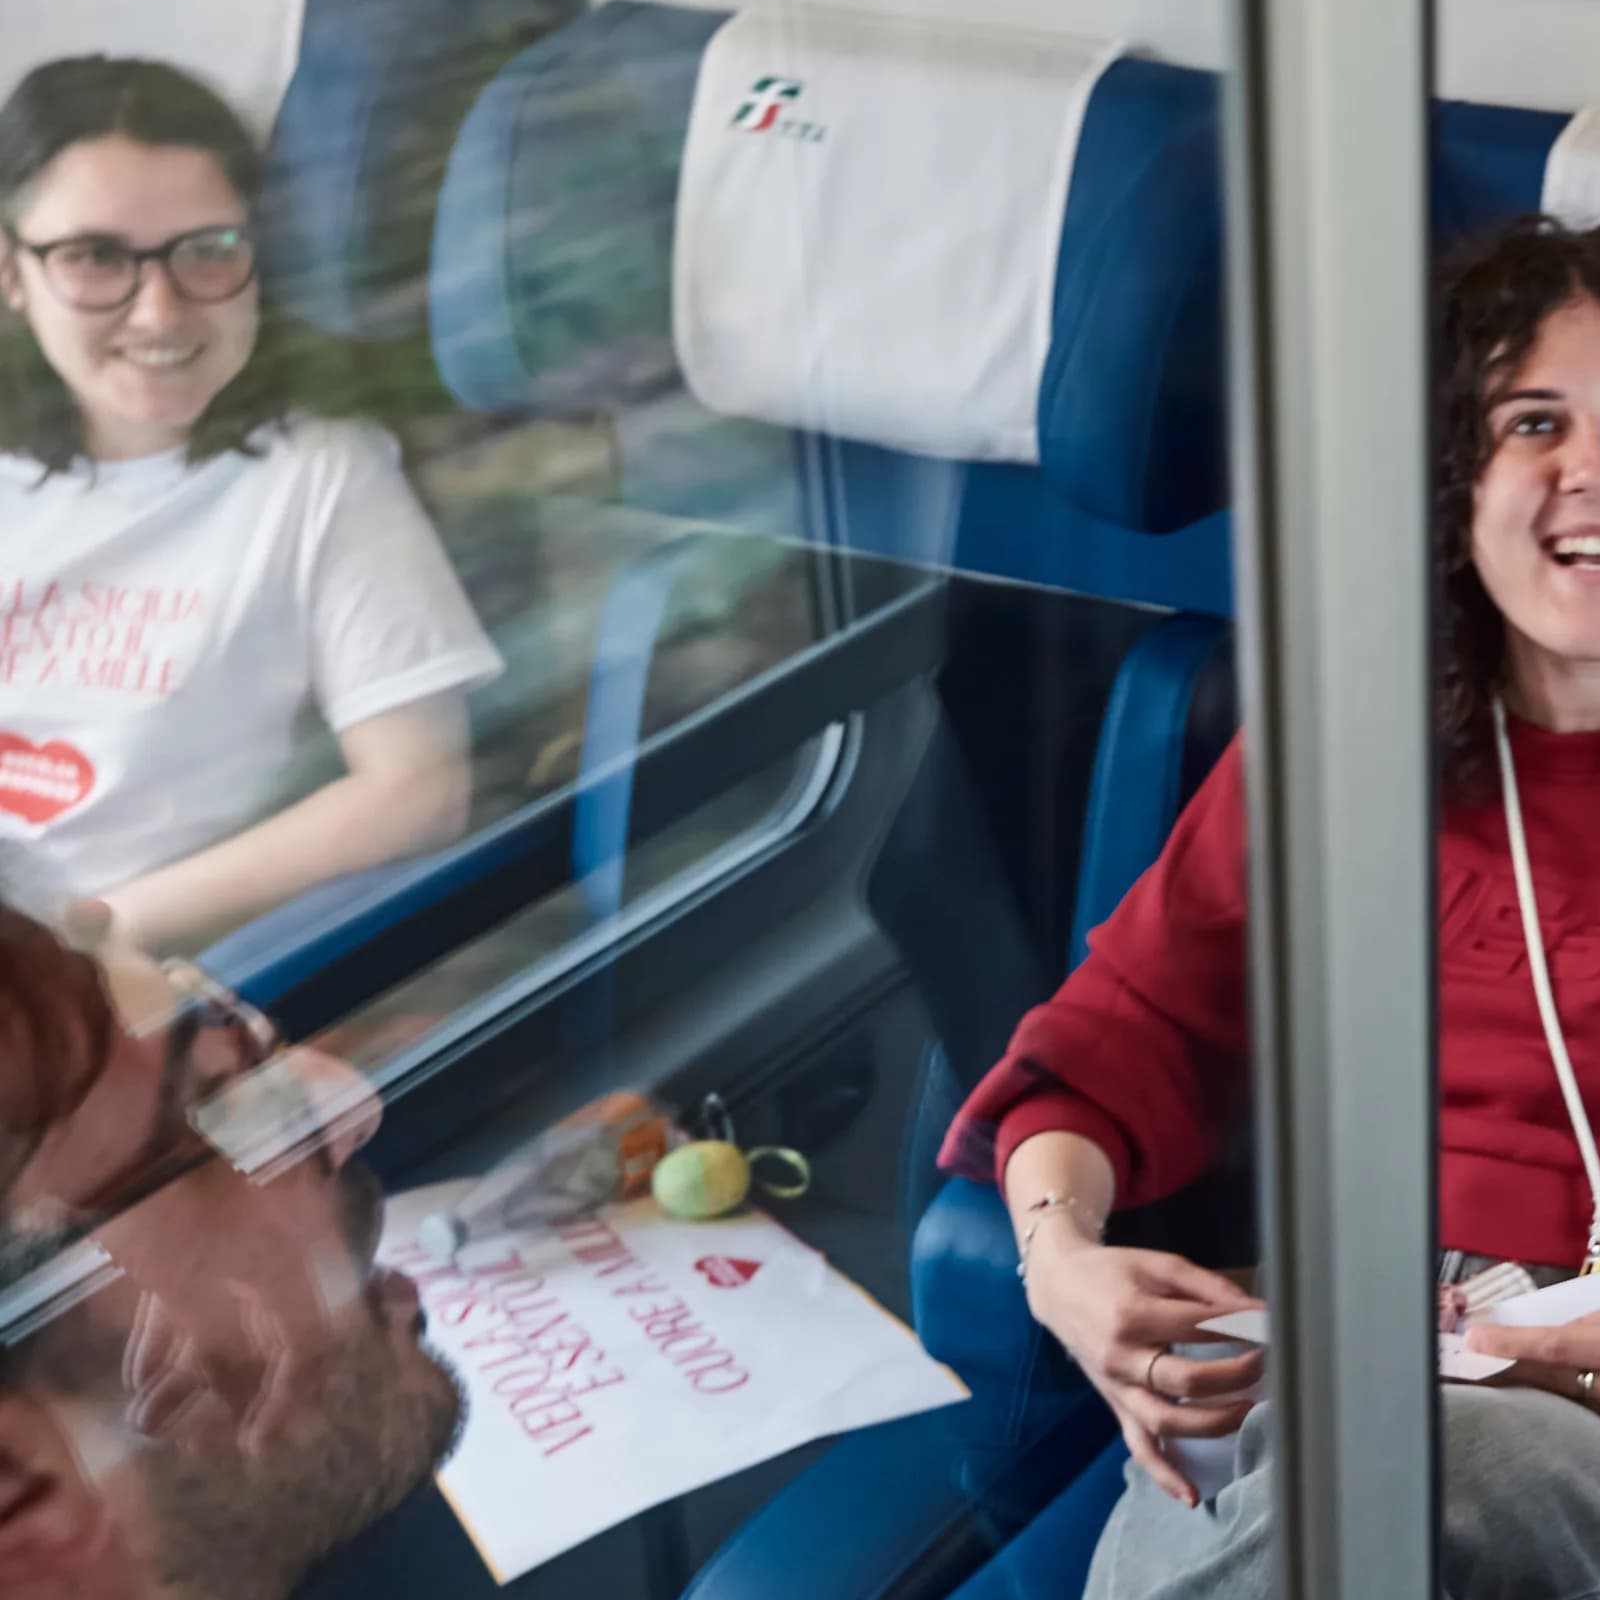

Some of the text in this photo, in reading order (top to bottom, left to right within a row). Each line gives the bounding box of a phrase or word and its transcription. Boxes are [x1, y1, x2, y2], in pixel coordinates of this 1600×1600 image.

[491, 1271, 605, 1372] SENTO
[611, 1272, 671, 1298] A
[462, 1320, 529, 1371] LA
[627, 1295, 752, 1395] CUORE
[493, 1358, 594, 1458] VEDO
